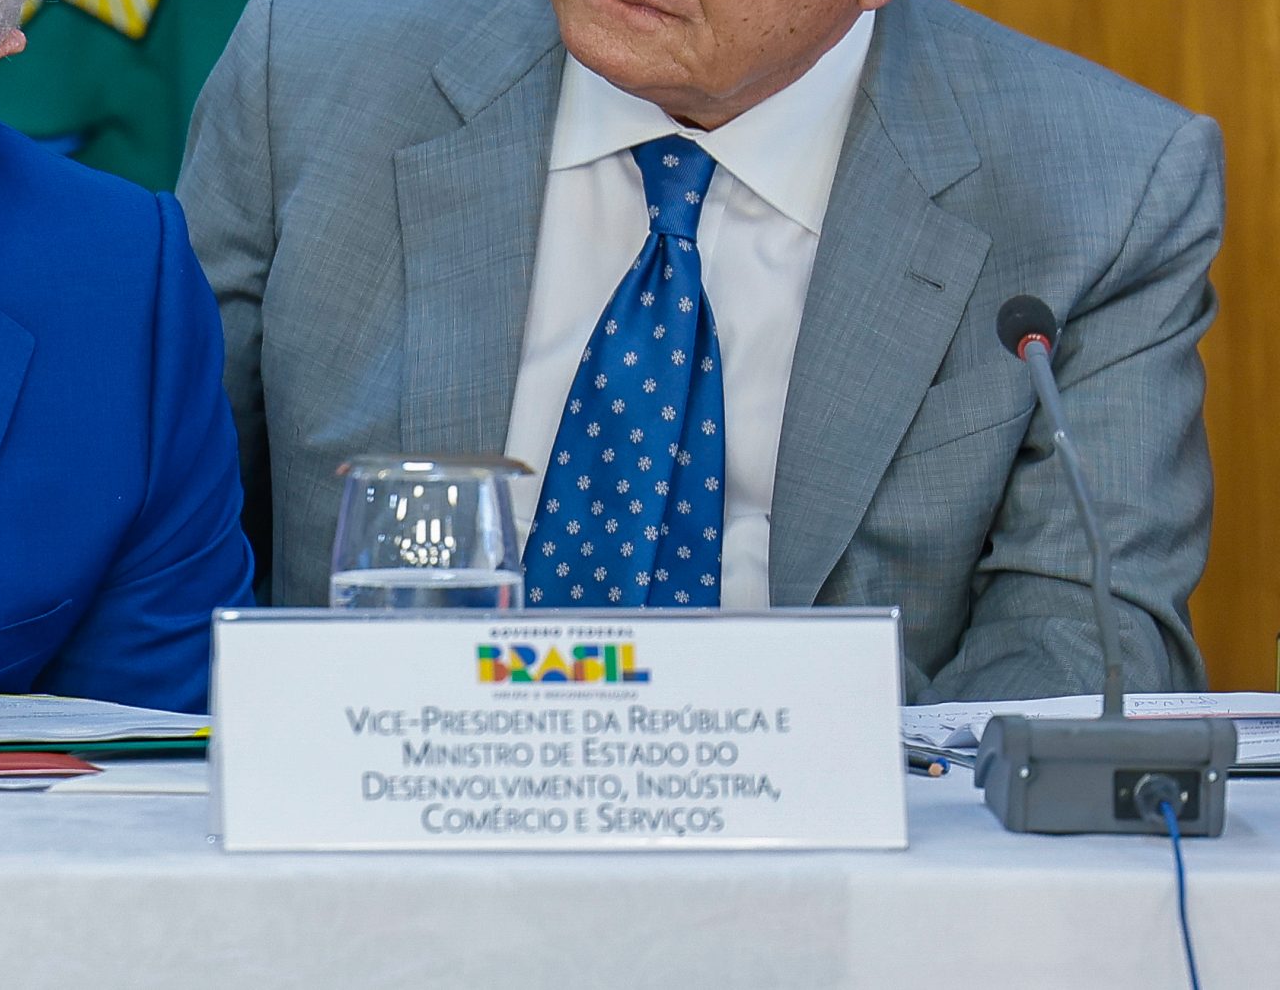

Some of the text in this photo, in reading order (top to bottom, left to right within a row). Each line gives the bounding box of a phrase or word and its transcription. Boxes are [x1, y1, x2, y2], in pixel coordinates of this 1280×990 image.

[476, 642, 652, 683] BRASIL
[582, 709, 621, 734] DA
[627, 704, 770, 735] REPÚBLICA
[775, 707, 791, 733] E
[401, 736, 740, 769] MINISTRO DE ESTADO DO
[421, 801, 725, 836] COMÉRCIO E SERVIÇOS
